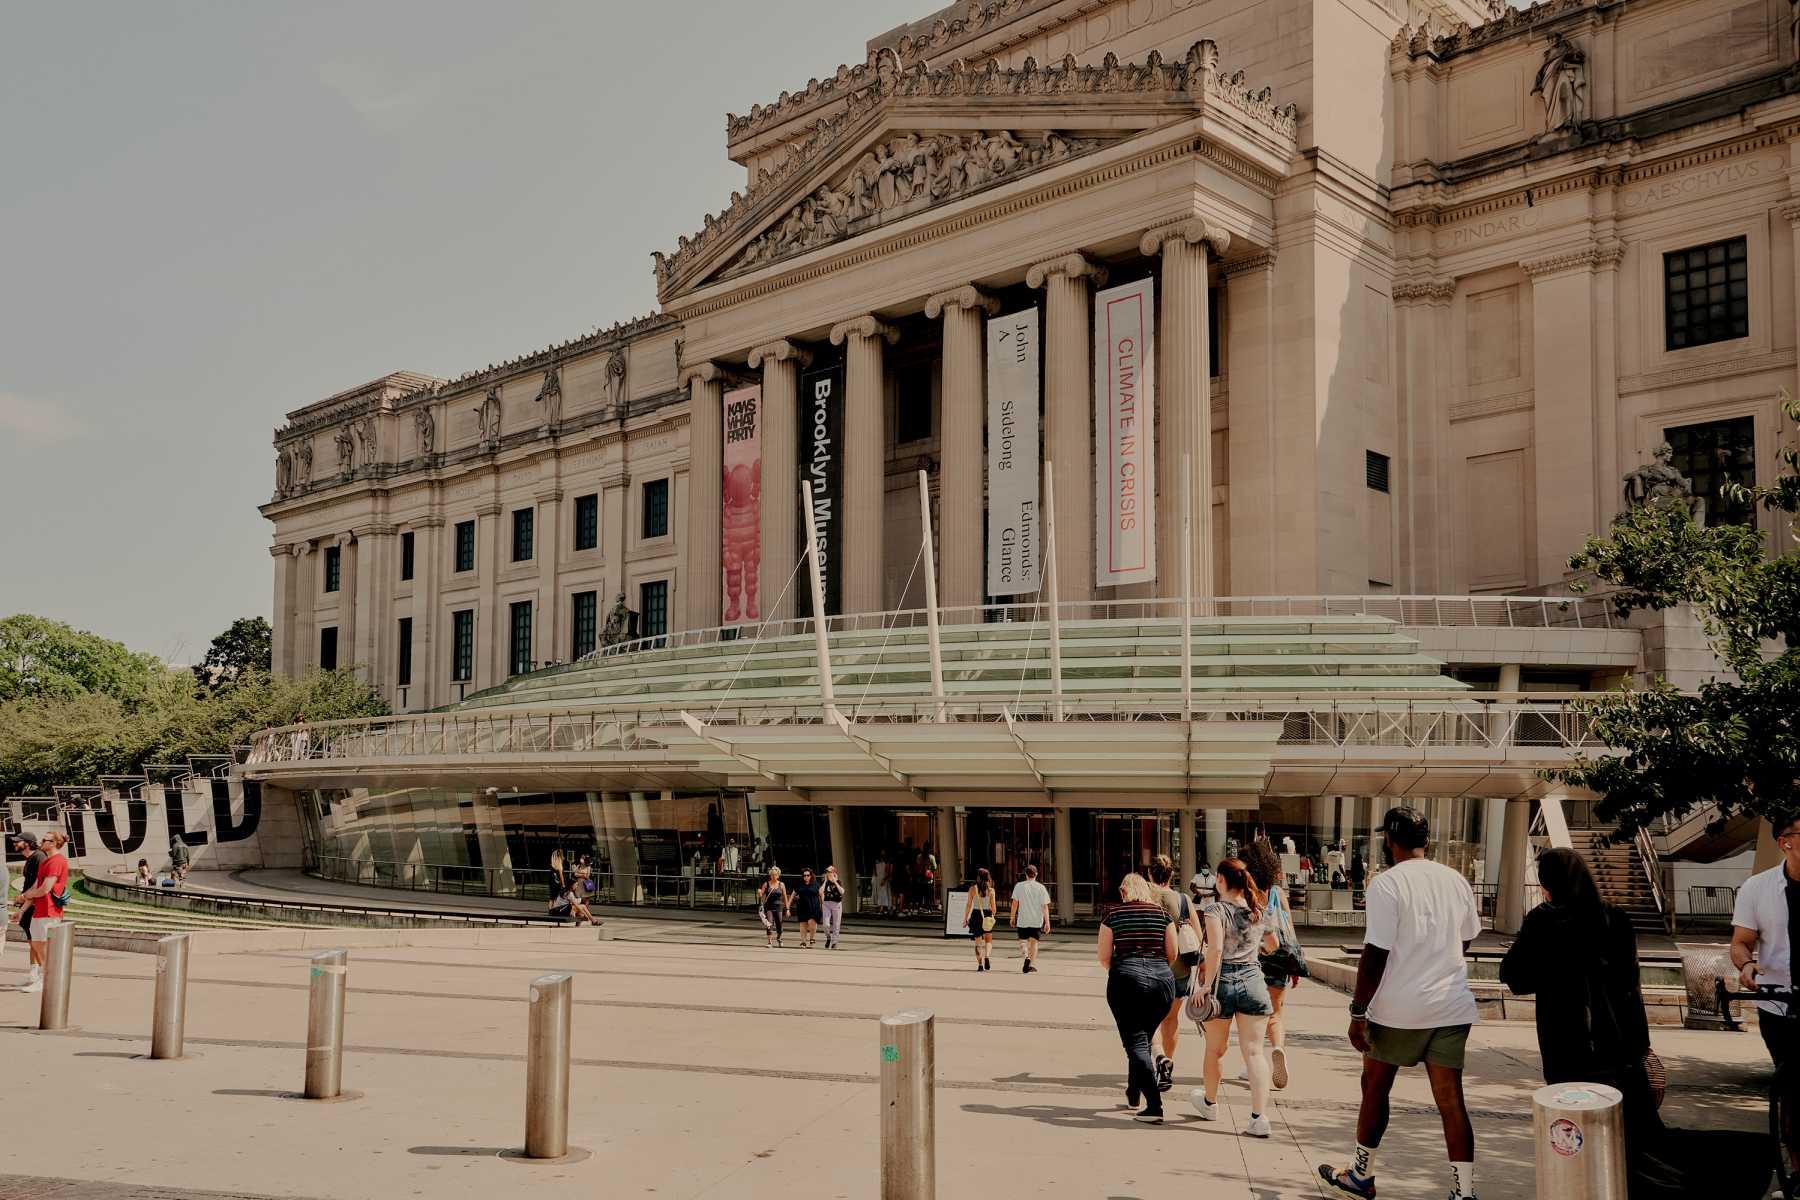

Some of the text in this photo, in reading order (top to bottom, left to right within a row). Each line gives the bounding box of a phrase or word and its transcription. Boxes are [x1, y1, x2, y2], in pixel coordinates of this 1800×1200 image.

[1453, 215, 1522, 244] PINDAR
[728, 398, 756, 417] KAWS
[728, 411, 756, 430] WHAT
[728, 424, 756, 444] PARTY
[1118, 338, 1136, 531] CLIMATE IN CRISIS
[811, 379, 831, 494] Brooklyn
[998, 400, 1015, 471] Sidelong
[1015, 324, 1033, 581] John Edmonds:
[1001, 528, 1016, 583] Glance
